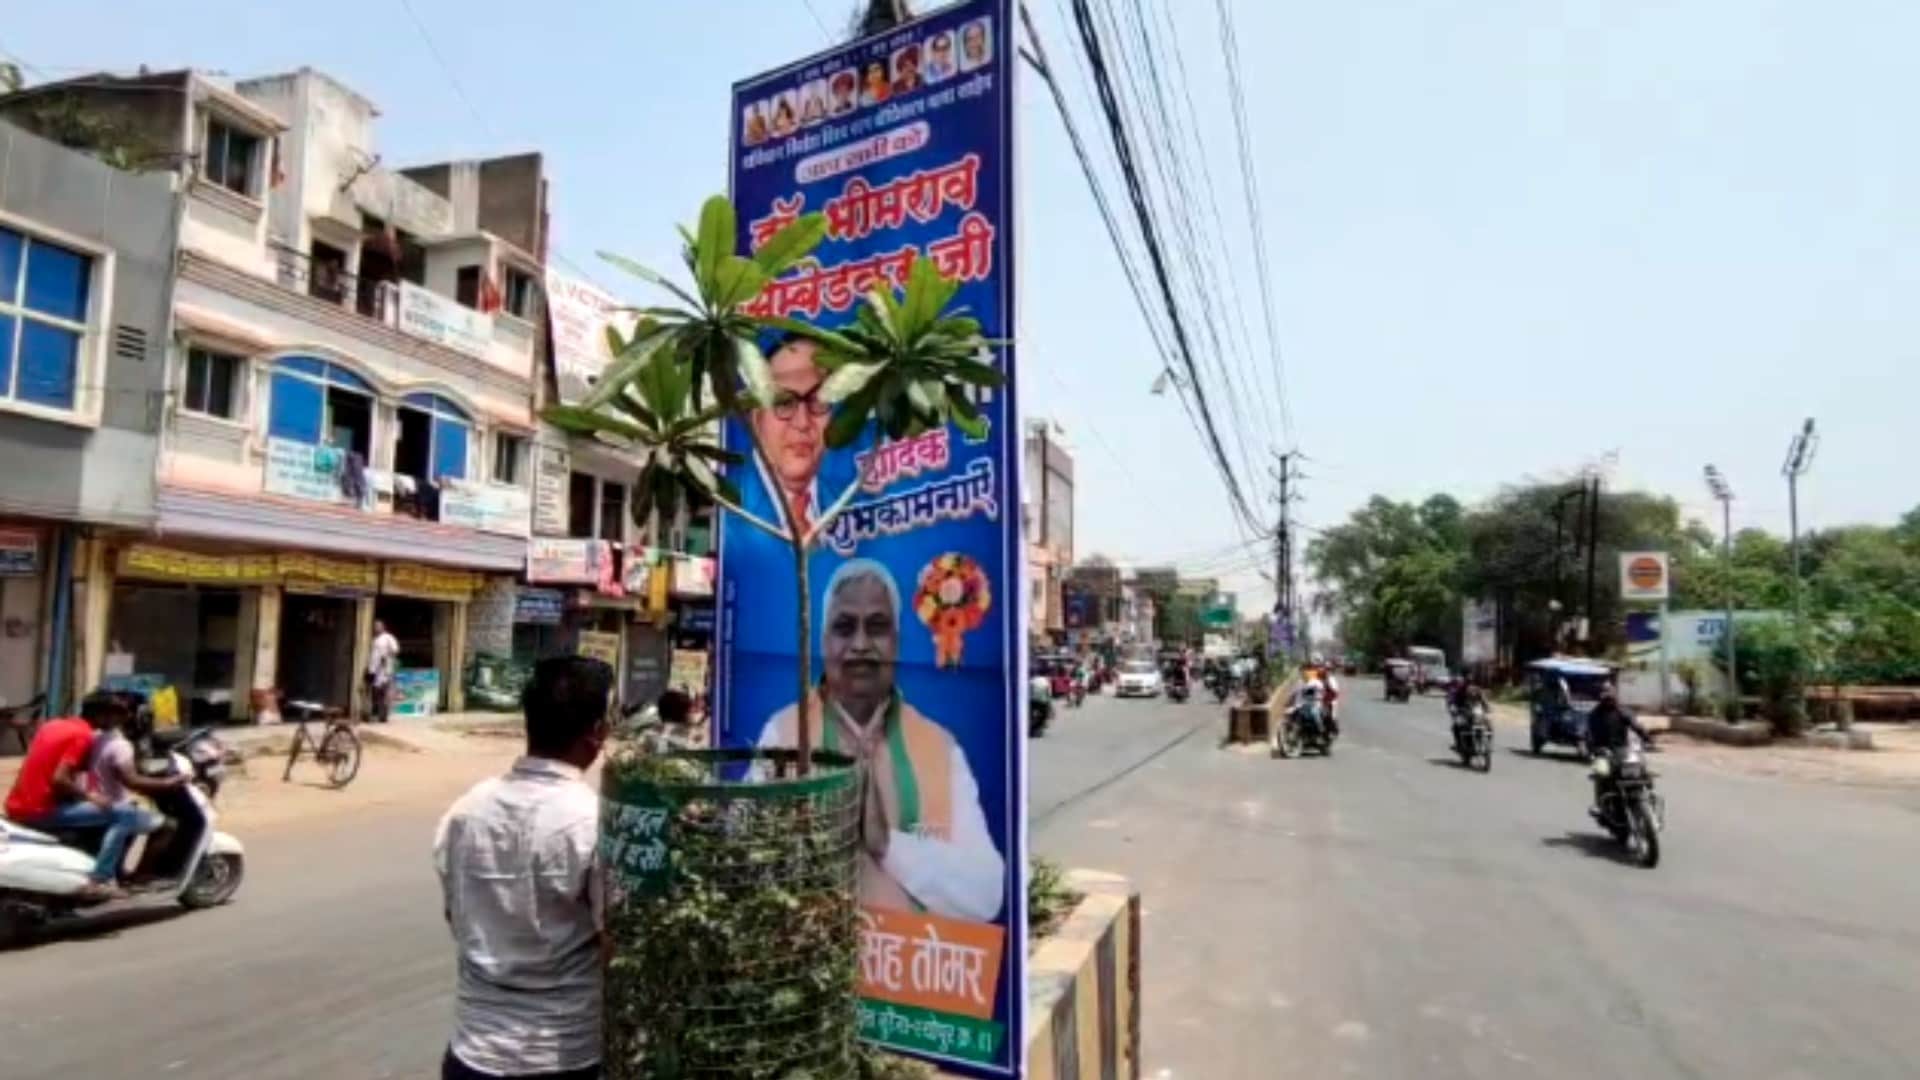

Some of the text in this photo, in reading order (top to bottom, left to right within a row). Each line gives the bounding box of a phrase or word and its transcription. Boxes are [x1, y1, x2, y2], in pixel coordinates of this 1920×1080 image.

[824, 153, 980, 240] भीमराव
[927, 213, 995, 280] जी
[911, 922, 989, 1005] तोमर
